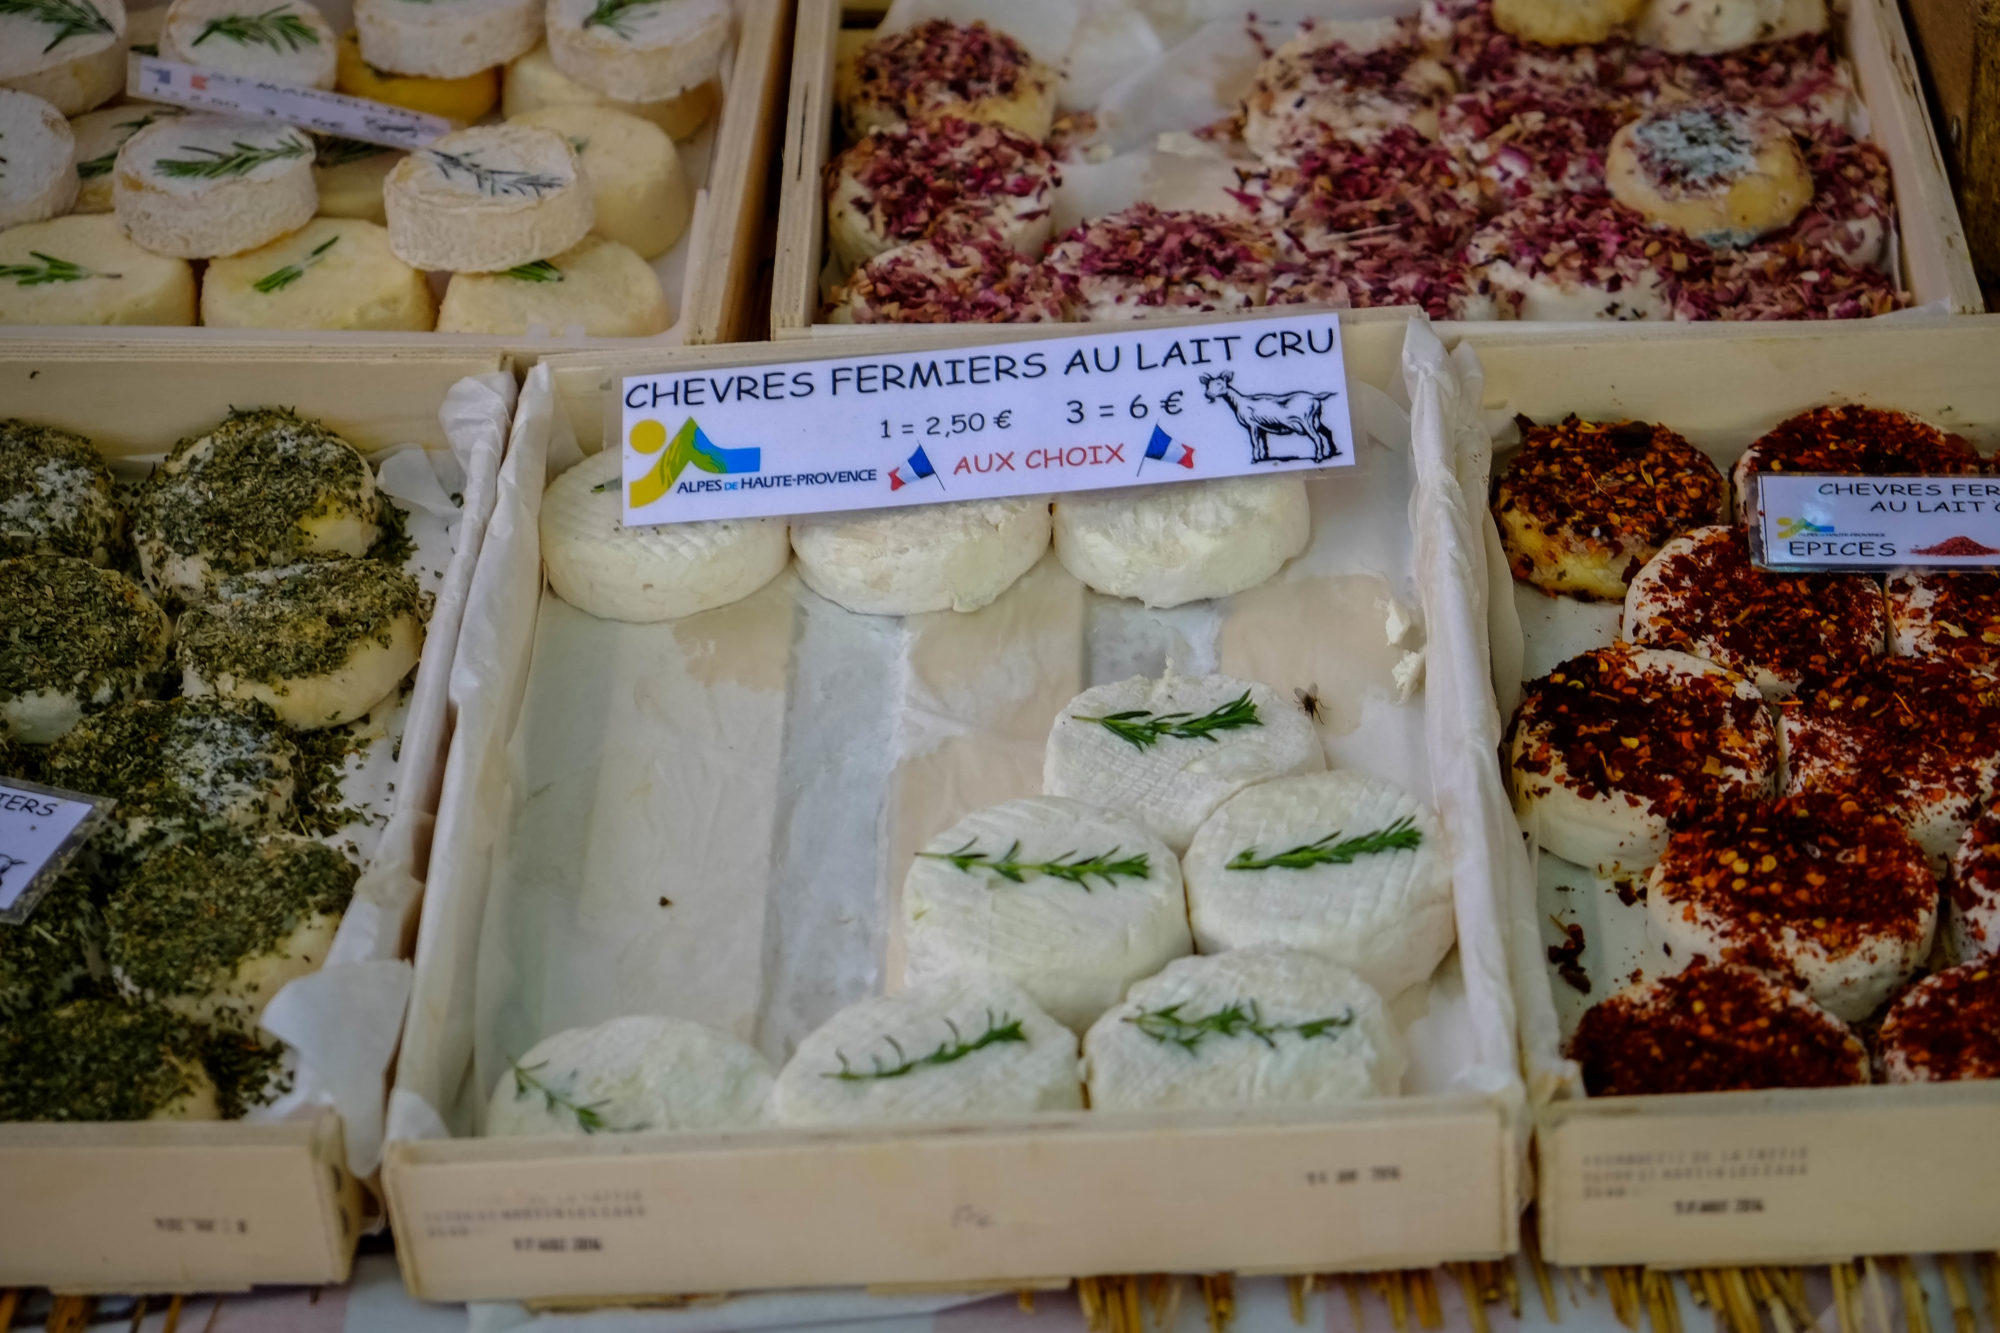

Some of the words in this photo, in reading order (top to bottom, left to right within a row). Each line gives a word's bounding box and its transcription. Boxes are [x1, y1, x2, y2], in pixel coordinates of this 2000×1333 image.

[625, 372, 814, 409] CHEVRES
[831, 353, 1047, 395] FERMIERS
[1064, 346, 1121, 376] AU
[1136, 336, 1241, 370] LAIT
[1255, 327, 1334, 359] CRU
[880, 420, 891, 438] 1
[926, 412, 985, 438] 2,50
[993, 409, 1012, 430] €
[1066, 400, 1085, 424] 3
[1129, 394, 1148, 419] 6
[1160, 390, 1184, 415] €
[953, 451, 1015, 476] AUX
[1025, 443, 1125, 469] CHOIX
[677, 479, 722, 494] ALPES
[724, 481, 738, 491] DE
[740, 469, 877, 490] HAUTE-PROVENCE
[1818, 483, 1942, 496] CHEVRES
[1870, 501, 1907, 513] AU
[1917, 501, 1985, 513] LAIT
[1789, 541, 1896, 557] EPICES
